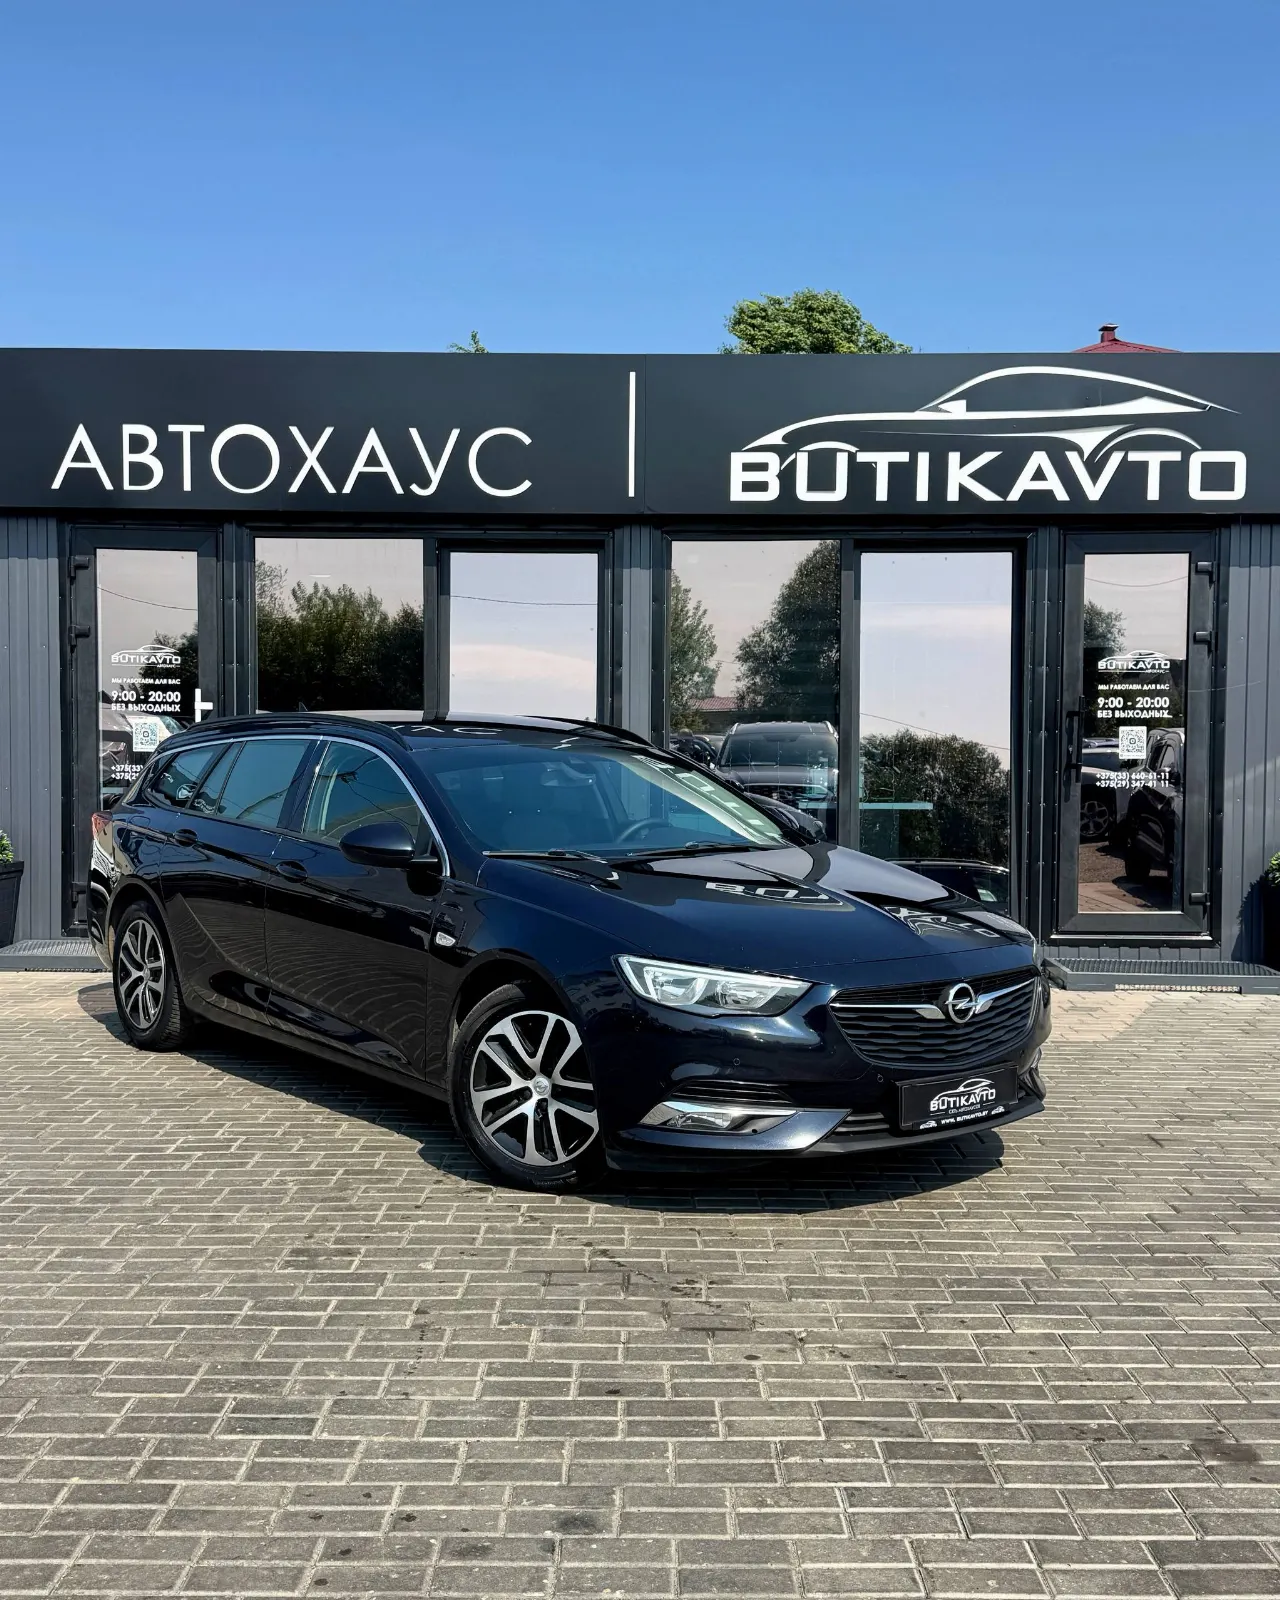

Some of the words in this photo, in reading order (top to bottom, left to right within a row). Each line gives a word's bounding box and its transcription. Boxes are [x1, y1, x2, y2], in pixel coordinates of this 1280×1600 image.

[51, 423, 532, 496] АВТОХАУС
[730, 450, 1246, 501] BUTIKAVTO
[111, 654, 181, 664] BUTIKAVTO
[1098, 660, 1170, 669] BUTIKAVTO
[111, 690, 136, 702] 9:00
[148, 691, 181, 702] 20:00
[111, 703, 126, 711] БЕЗ
[128, 703, 181, 712] ВЫХОДНЫХ
[1097, 697, 1124, 708] 9:00
[1135, 697, 1170, 708] 20:00
[1097, 710, 1113, 718] БЕЗ
[1114, 710, 1171, 718] ВЫХОДНЫХ
[1096, 772, 1130, 780] +375(33)
[1131, 772, 1170, 780] 660-61-11
[1096, 780, 1130, 788] +375(29)
[1131, 780, 1170, 788] 347-4111
[930, 1089, 996, 1111] BUTIKAVTO
